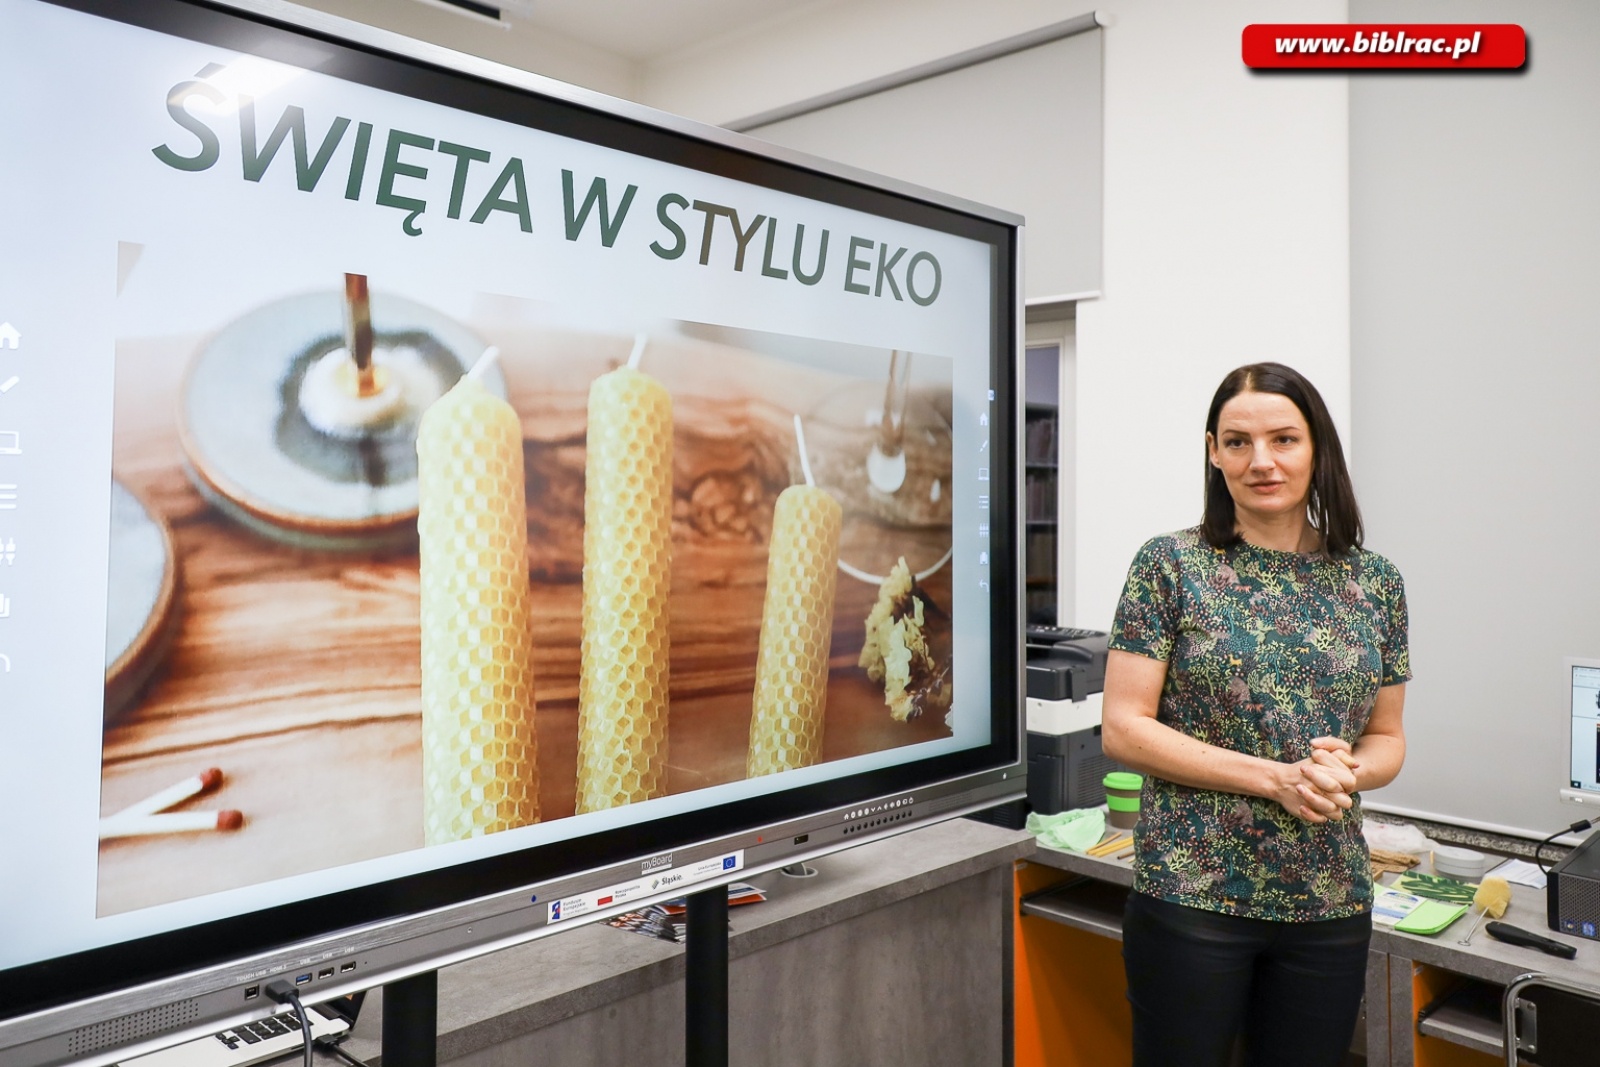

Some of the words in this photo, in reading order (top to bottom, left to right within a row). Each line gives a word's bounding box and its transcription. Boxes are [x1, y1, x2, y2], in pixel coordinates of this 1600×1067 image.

[151, 62, 533, 236] ŚWIĘTA
[561, 168, 638, 248] W
[649, 192, 830, 286] STYLU
[843, 236, 942, 307] EKO
[641, 852, 673, 870] myBoard
